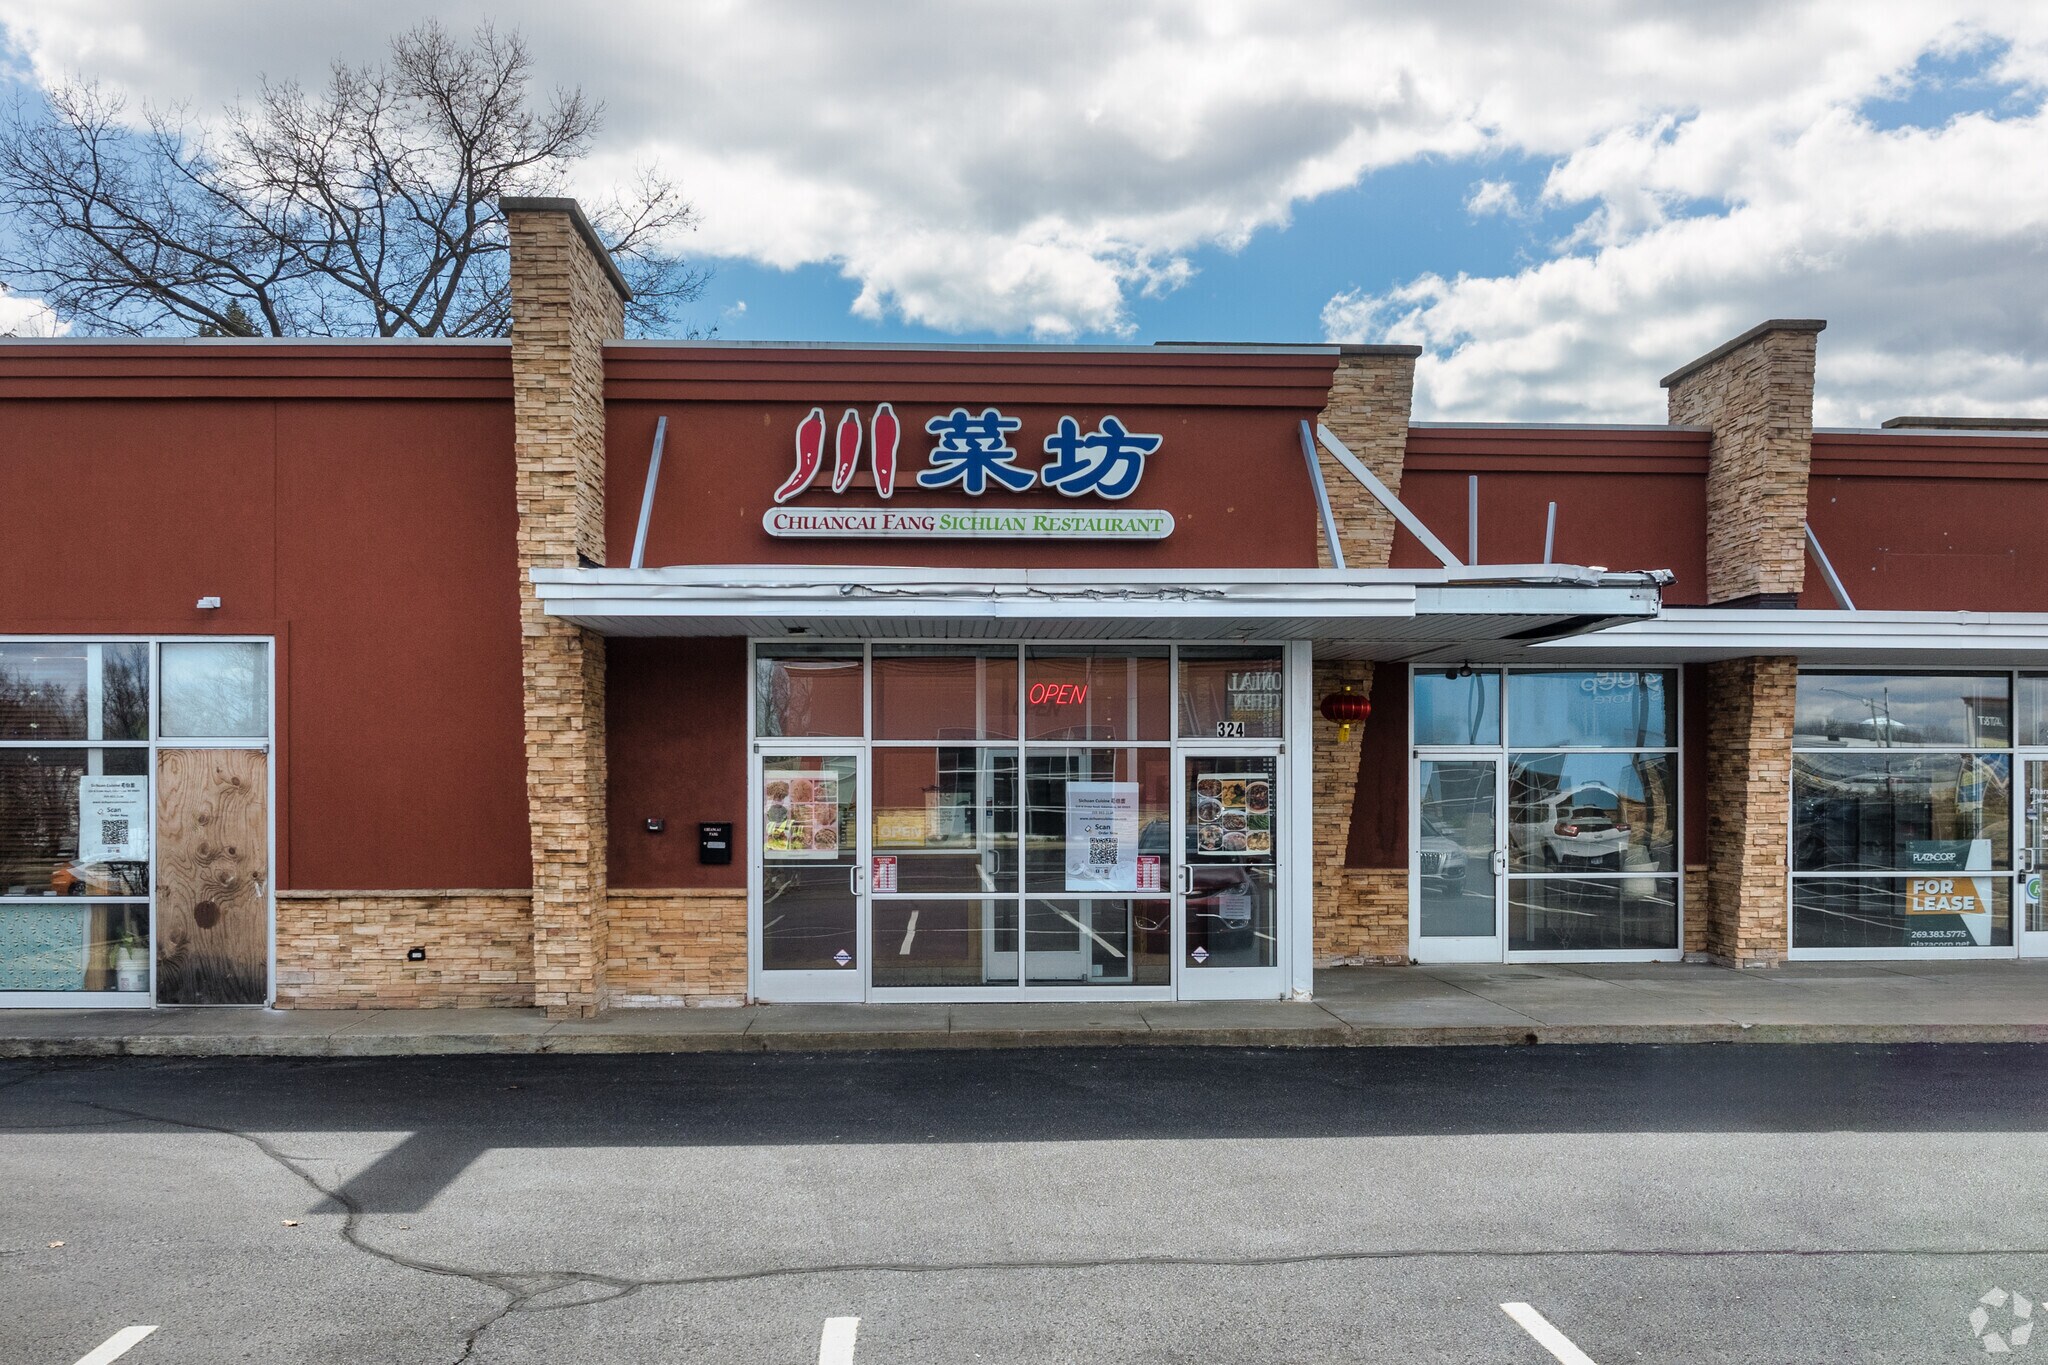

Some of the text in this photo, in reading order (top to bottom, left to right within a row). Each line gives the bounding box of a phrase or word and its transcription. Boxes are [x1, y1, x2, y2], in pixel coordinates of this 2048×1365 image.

[773, 513, 1164, 532] CHUANCAI FANG SICHUAN RESTAURANT
[1029, 682, 1088, 704] OPEN
[1217, 722, 1244, 737] 324
[1912, 852, 1957, 861] PLAZACORP
[1912, 879, 1955, 895] FOR
[1912, 895, 1975, 911] LEASE
[1911, 930, 1967, 939] 269.383.5775
